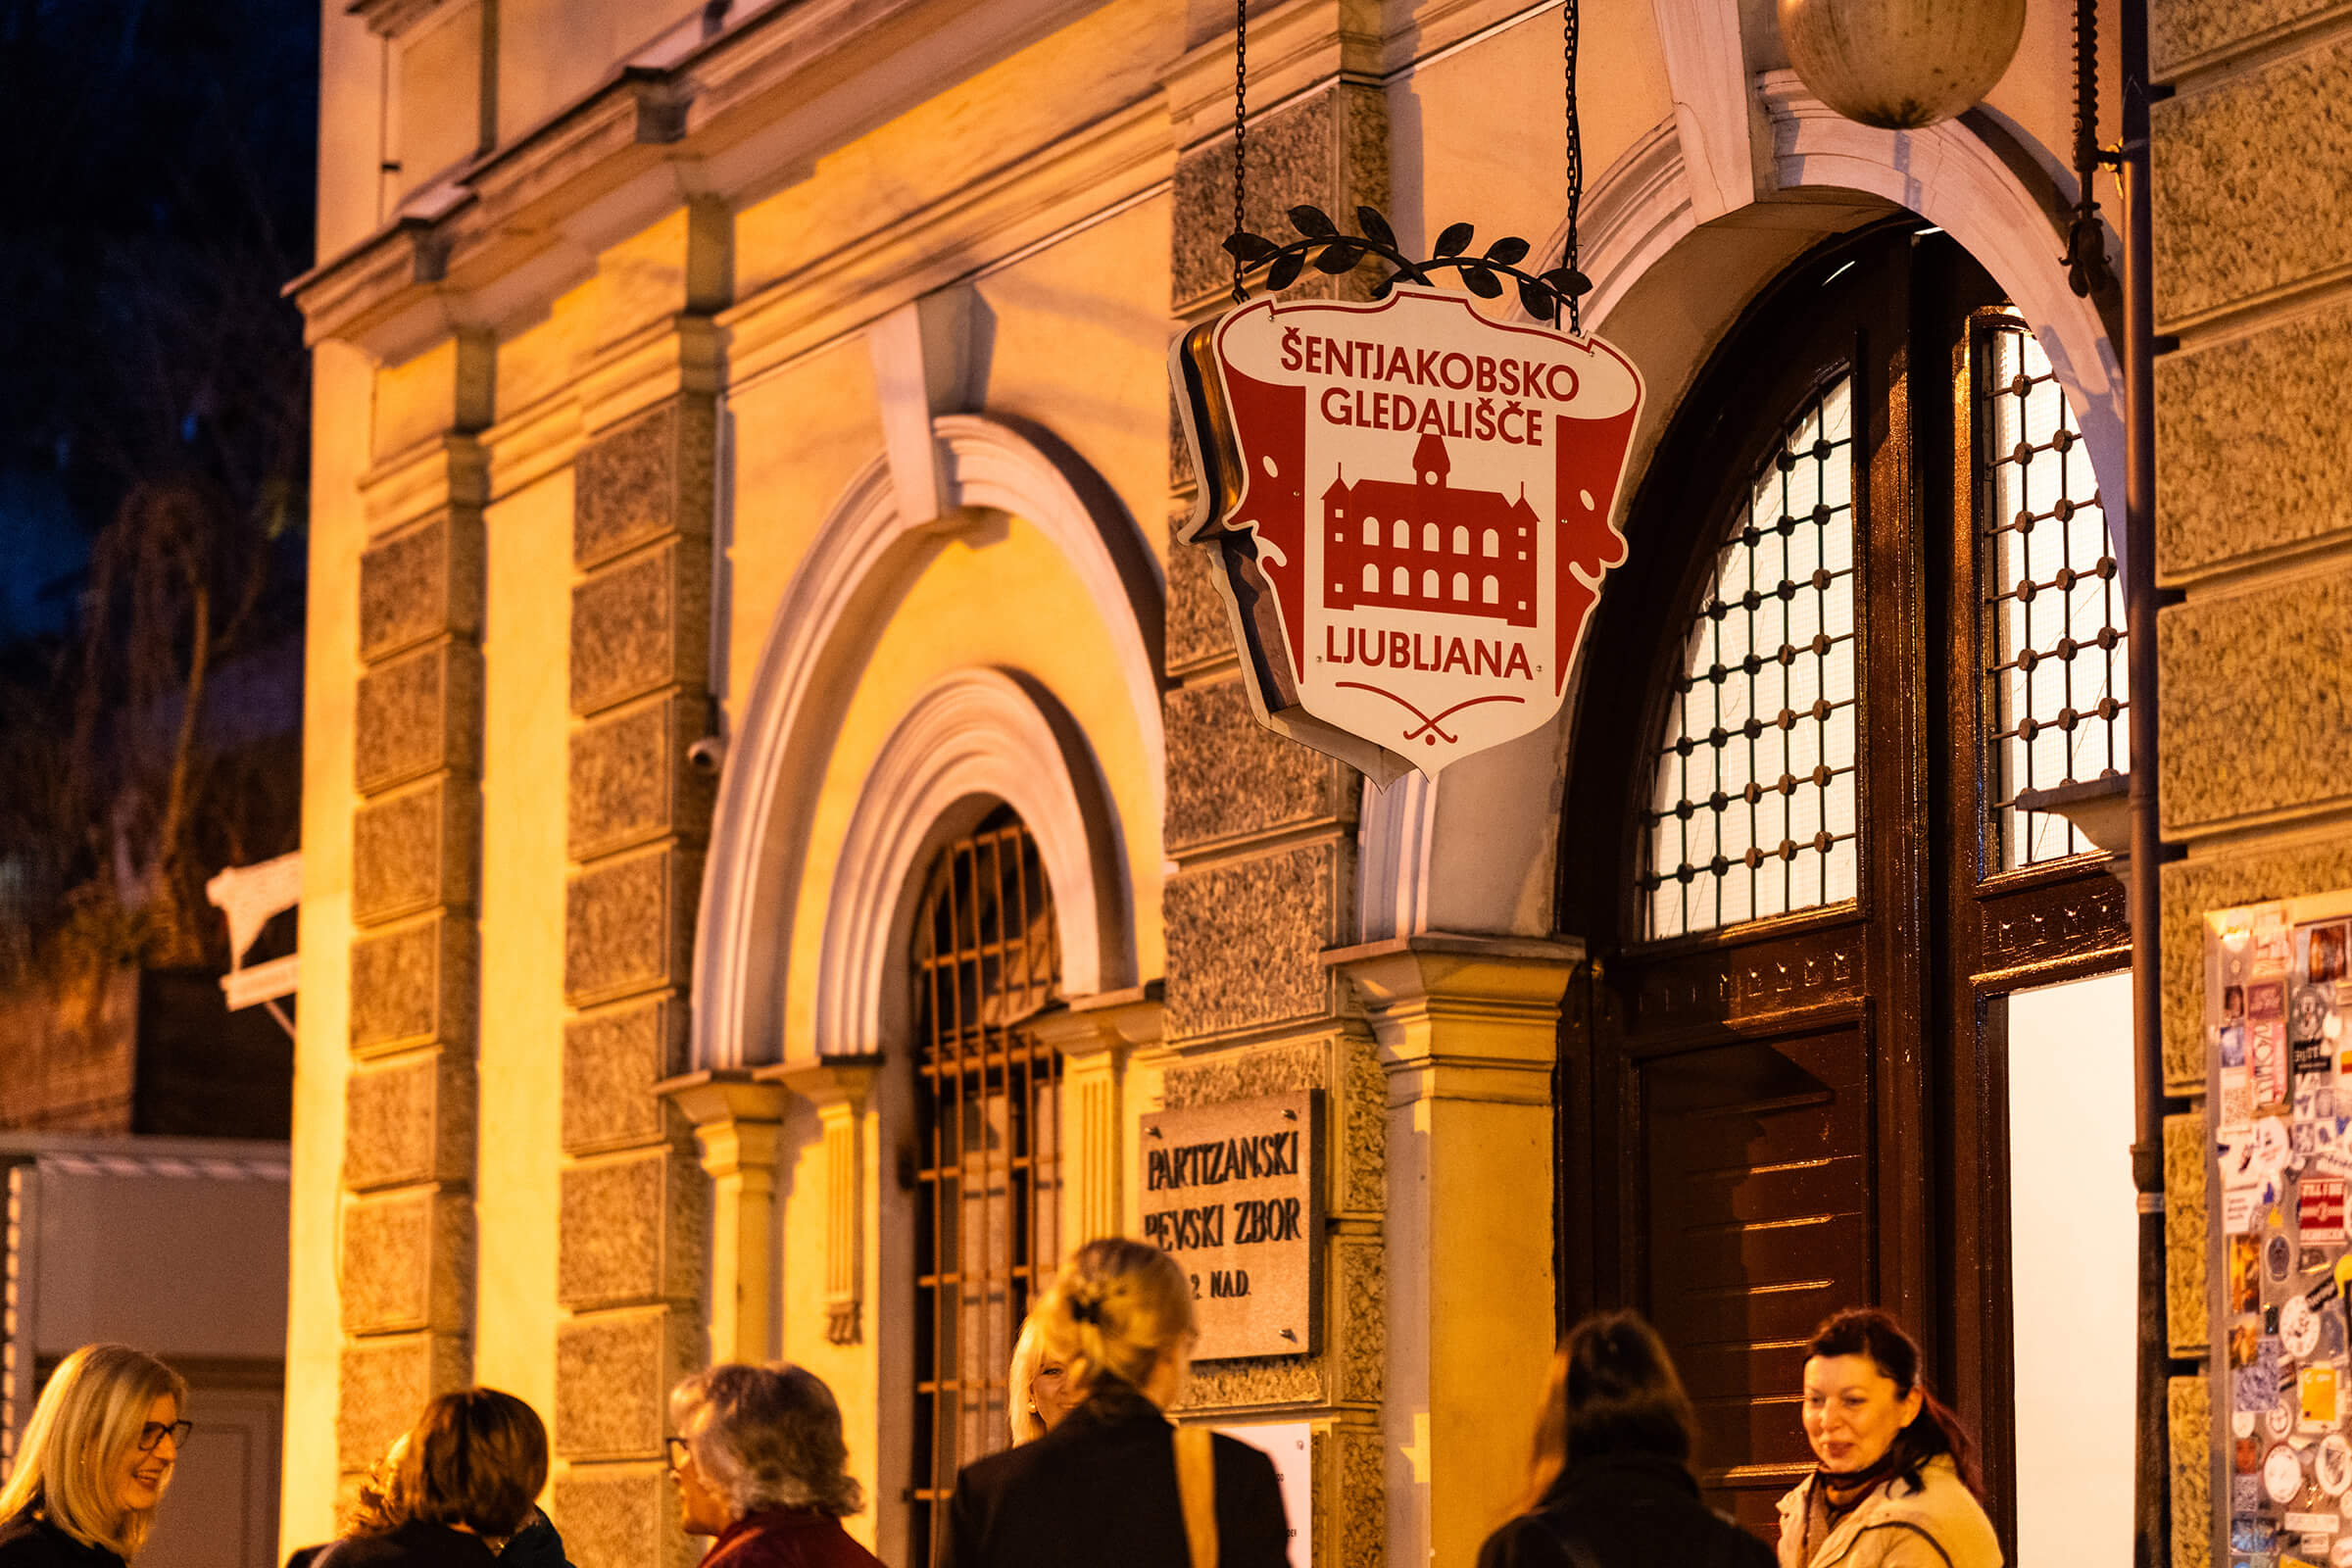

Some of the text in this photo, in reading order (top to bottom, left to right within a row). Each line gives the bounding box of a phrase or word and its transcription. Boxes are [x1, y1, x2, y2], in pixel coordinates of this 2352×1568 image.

[1281, 326, 1580, 402] ŠENTJAKOBSKO
[1320, 387, 1544, 447] GLEDALIŠČE
[1326, 625, 1534, 680] LJUBLJANA
[1148, 1131, 1299, 1191] PARTIZANSKI
[1145, 1197, 1302, 1251] PEVSKI ZBOR
